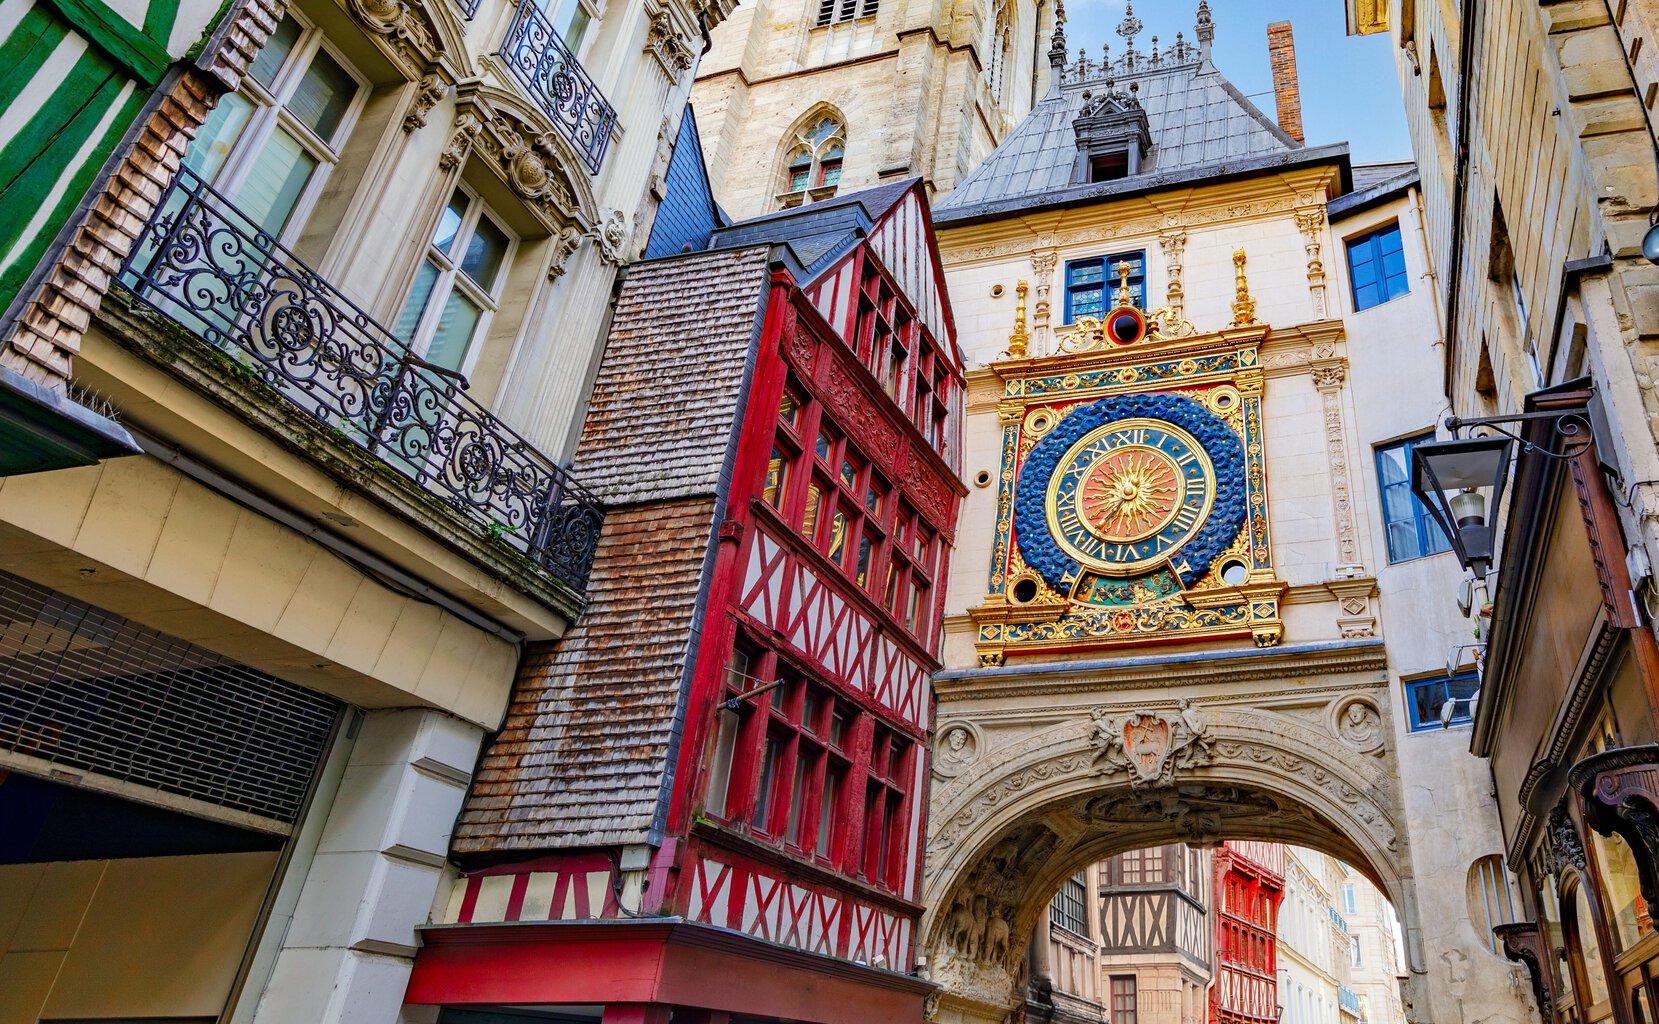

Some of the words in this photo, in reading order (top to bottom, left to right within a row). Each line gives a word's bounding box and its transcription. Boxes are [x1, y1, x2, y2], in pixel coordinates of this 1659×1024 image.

[1116, 429, 1145, 447] XII
[1156, 433, 1168, 448] I
[1086, 438, 1111, 461] XI
[1177, 451, 1196, 467] II
[1066, 461, 1087, 479] X
[1186, 477, 1205, 495] III
[1057, 490, 1075, 511] IX
[1173, 504, 1199, 531] IIII
[1080, 536, 1106, 560] VII
[1157, 534, 1174, 553] V
[1115, 544, 1141, 562] VI
